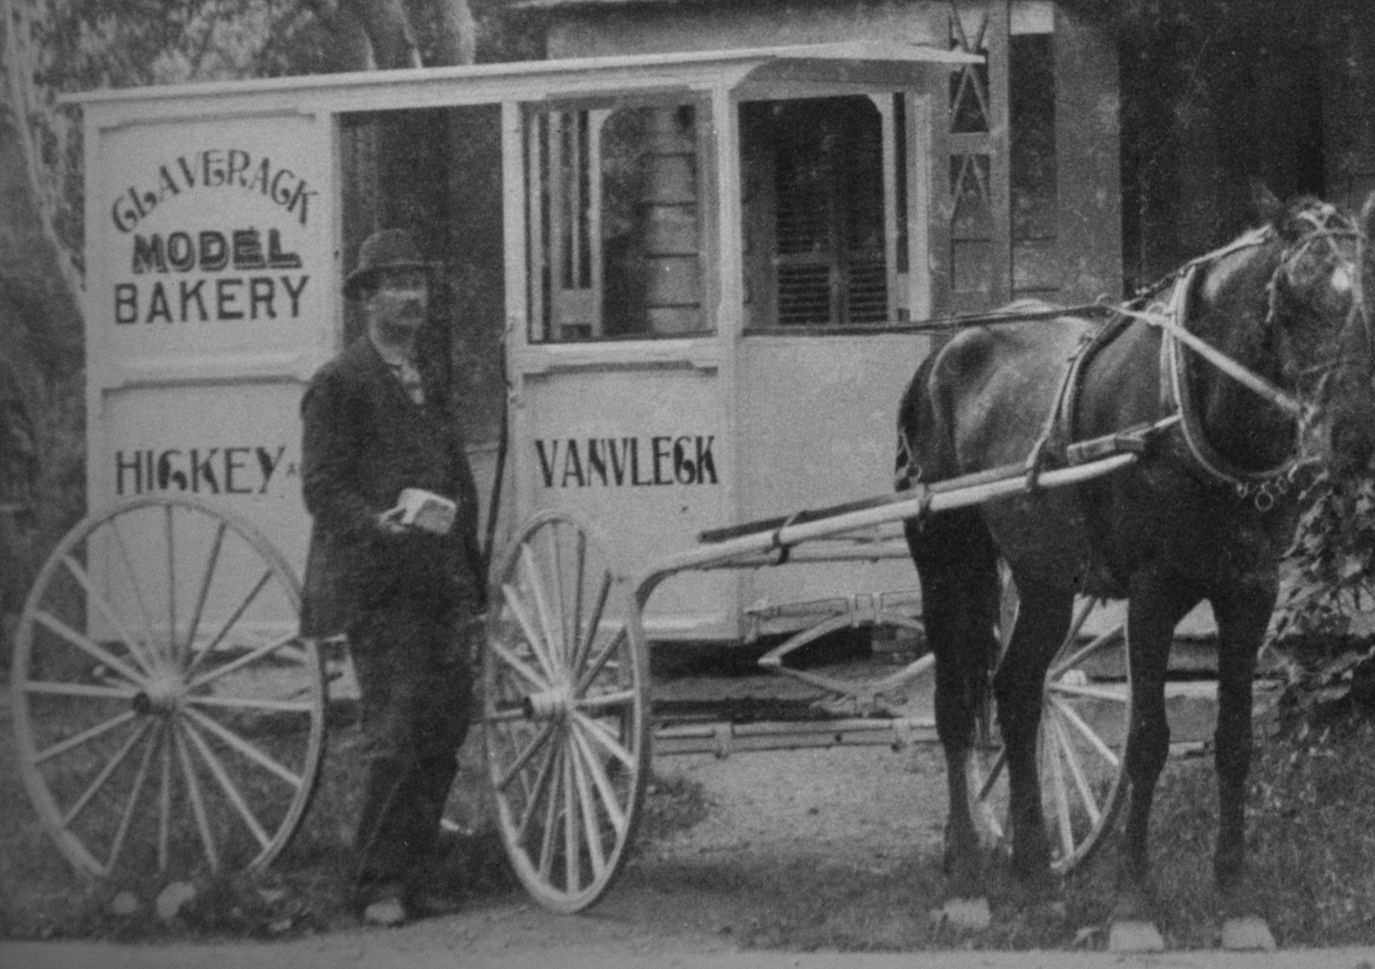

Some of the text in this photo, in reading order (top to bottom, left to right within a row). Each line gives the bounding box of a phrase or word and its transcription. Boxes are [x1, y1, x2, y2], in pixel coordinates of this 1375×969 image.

[111, 148, 318, 234] CLAVERACK
[131, 226, 303, 275] MODEL
[113, 275, 310, 325] BAKERY
[115, 445, 286, 496] HICKEY
